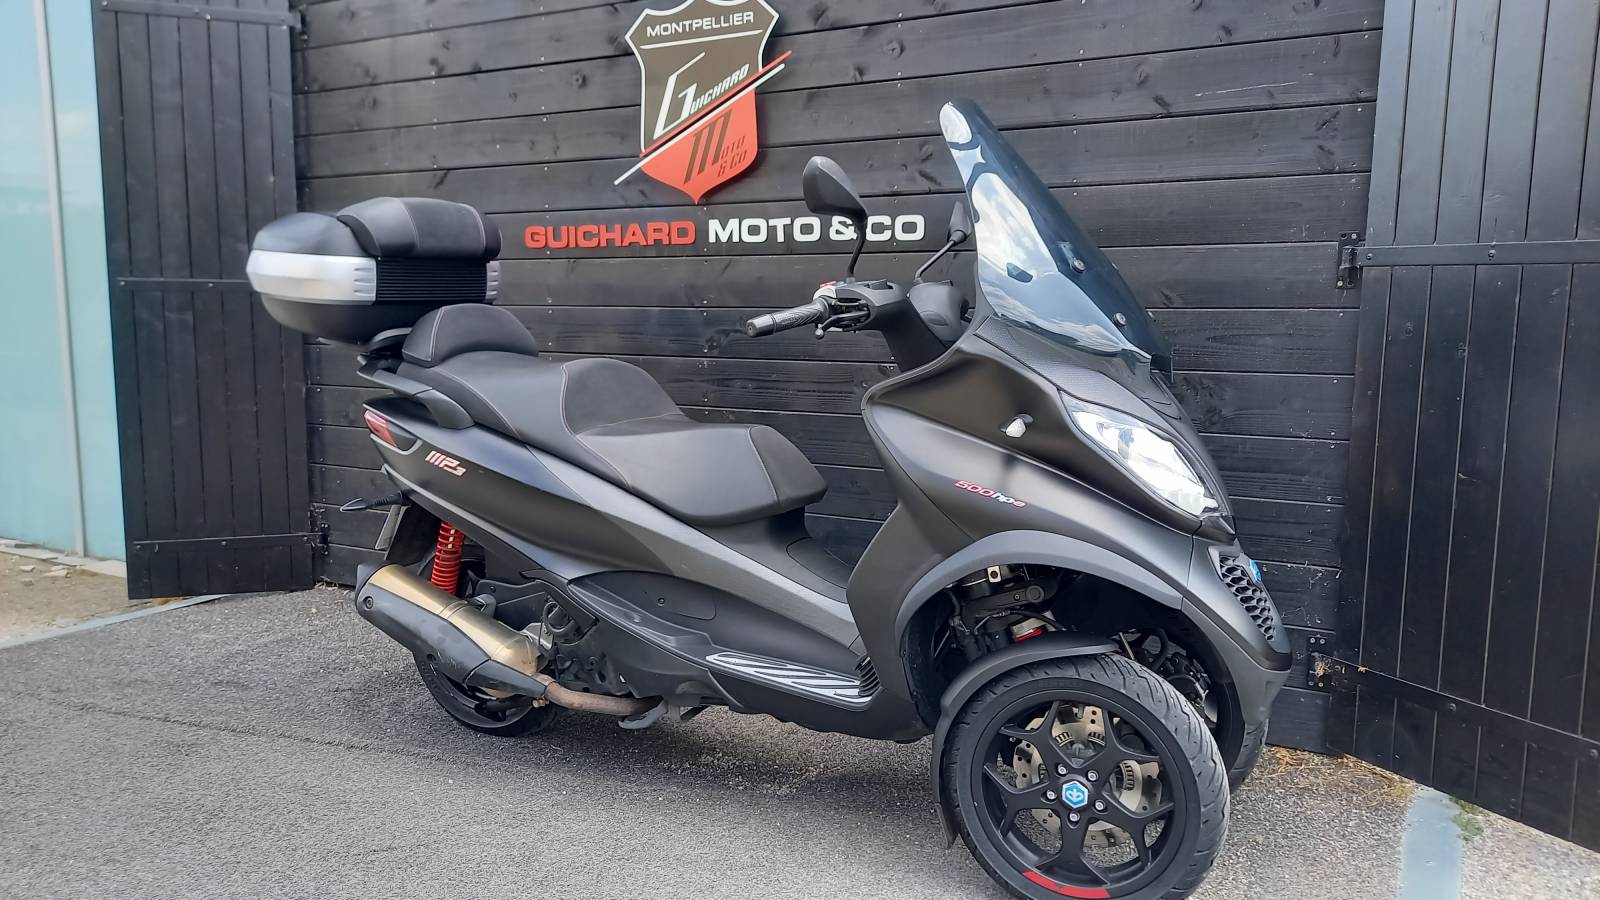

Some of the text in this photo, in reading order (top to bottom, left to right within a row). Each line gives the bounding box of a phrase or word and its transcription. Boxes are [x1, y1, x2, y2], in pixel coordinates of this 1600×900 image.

[646, 11, 754, 38] MONTPELLIER
[524, 220, 696, 249] GUICHARD
[708, 216, 822, 243] MOTO
